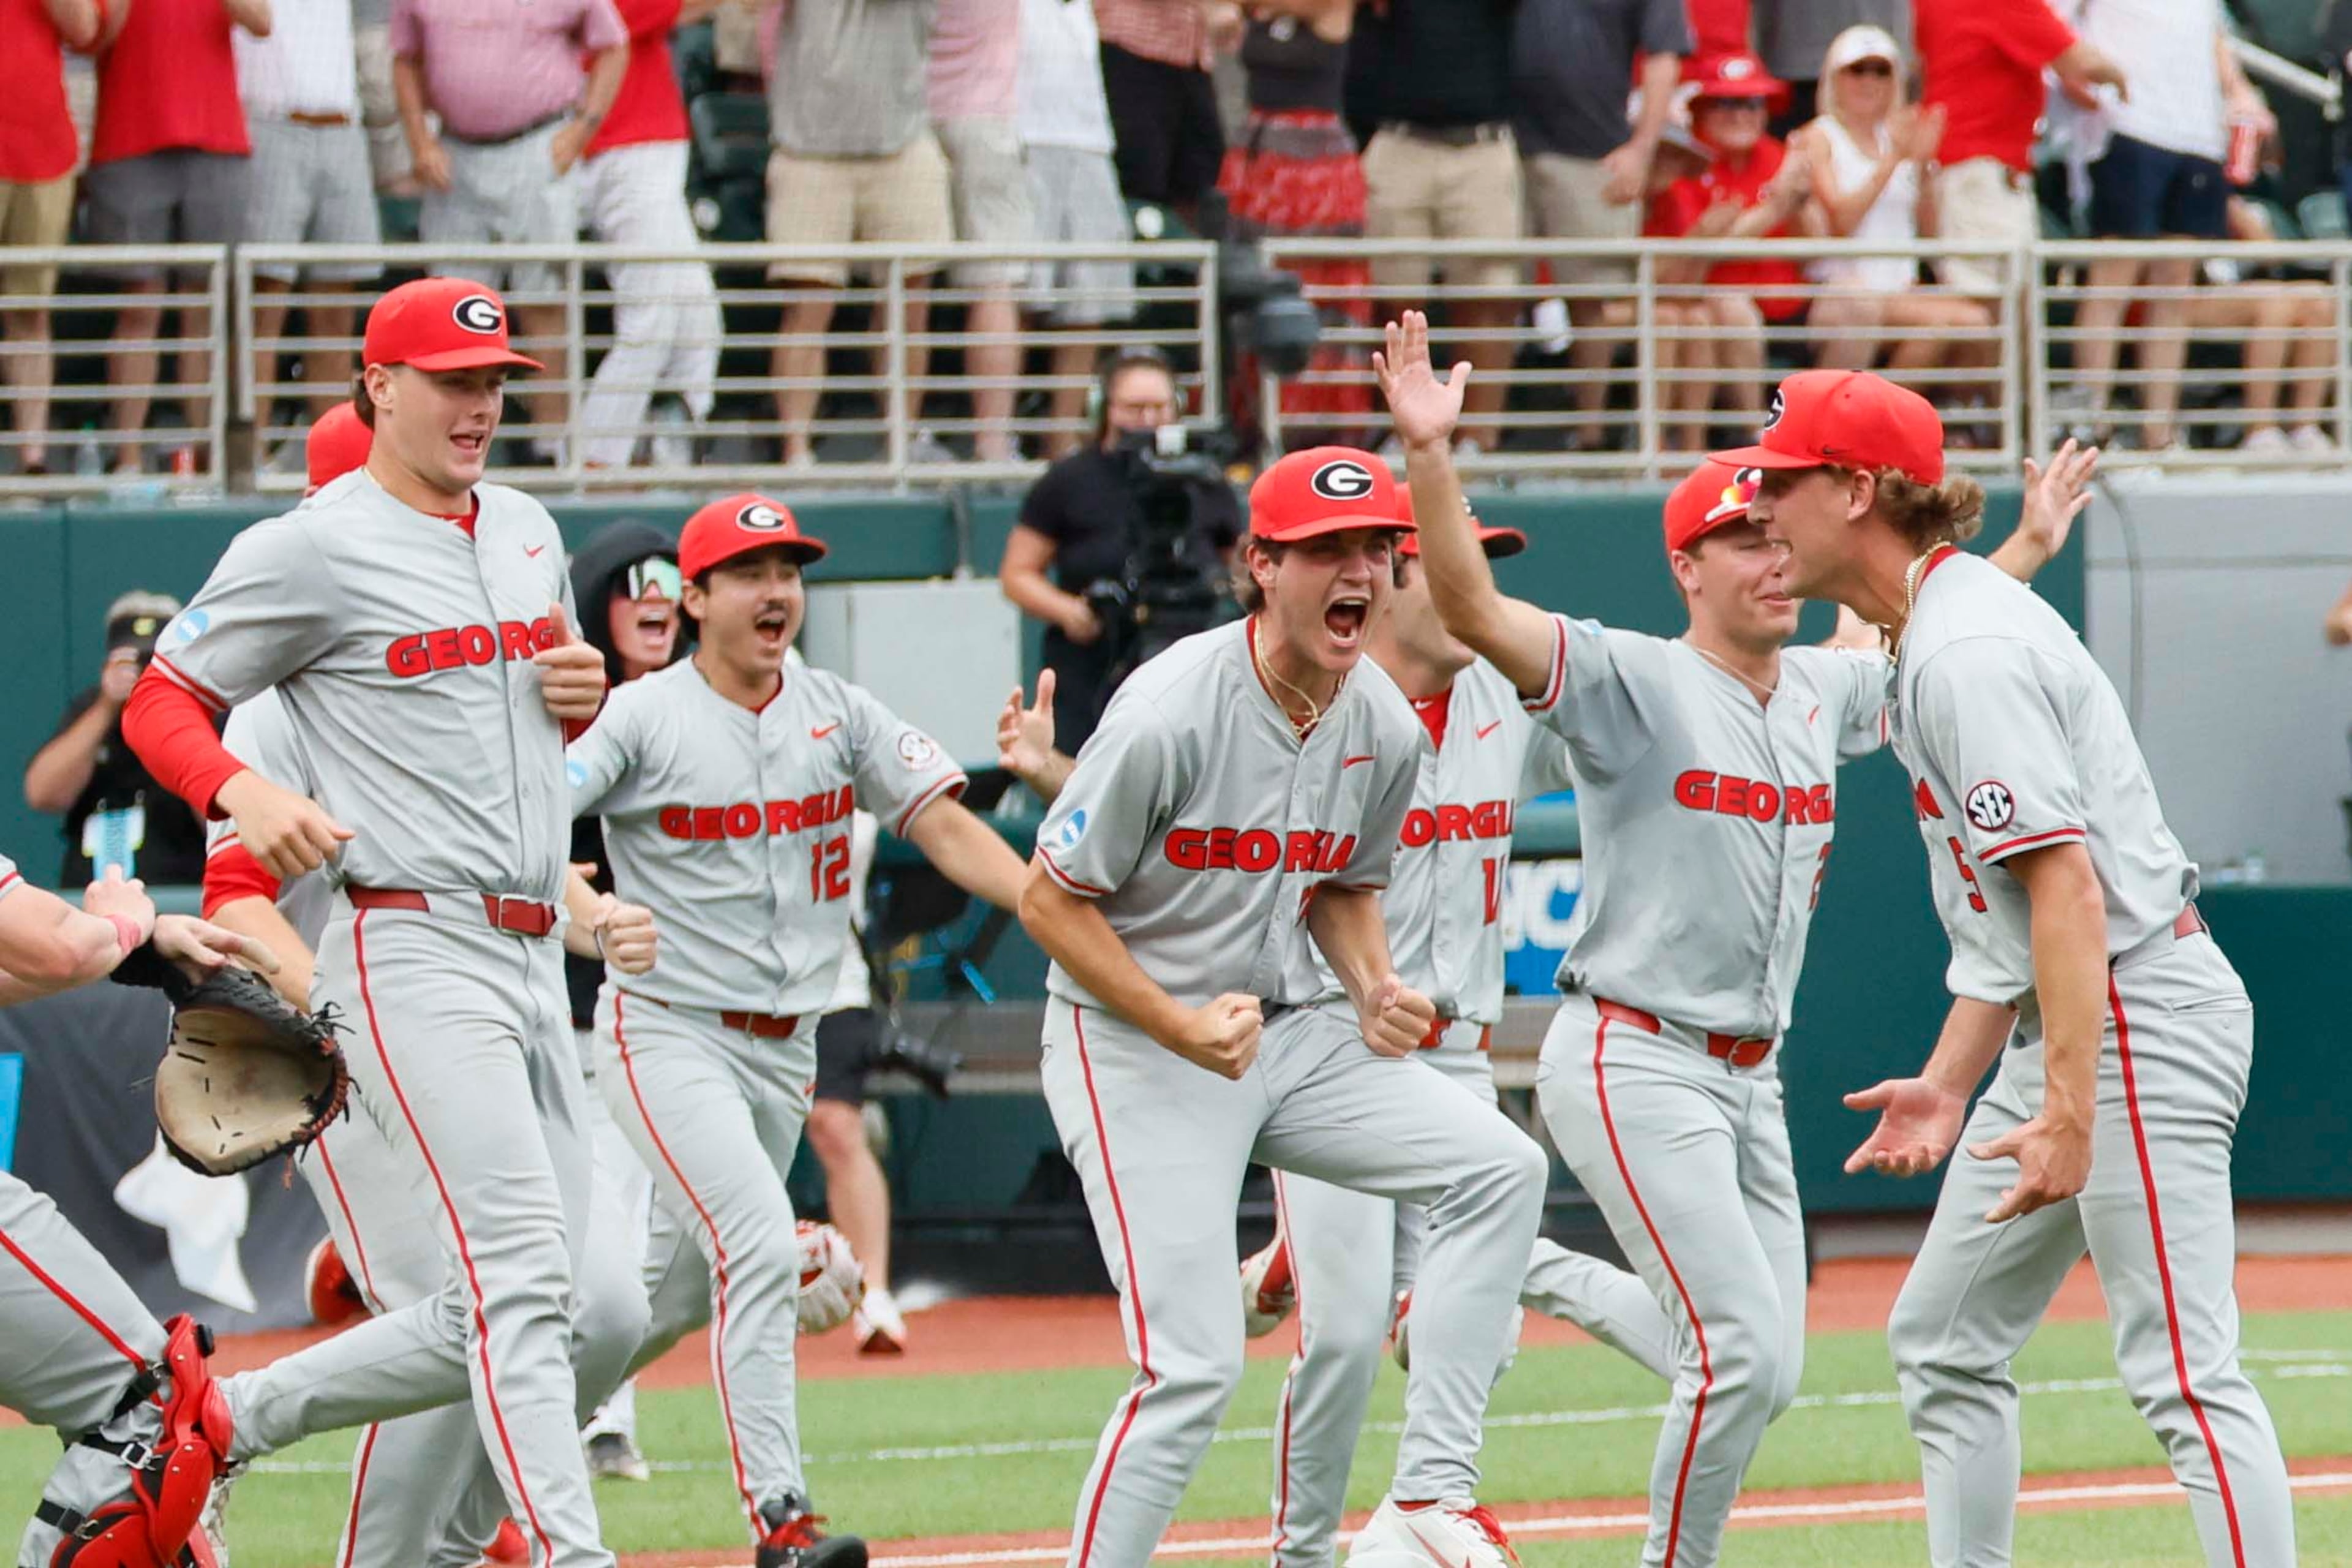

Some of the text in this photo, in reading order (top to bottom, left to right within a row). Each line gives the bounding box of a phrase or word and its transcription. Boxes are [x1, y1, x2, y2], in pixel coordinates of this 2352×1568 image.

[455, 297, 502, 331] G
[1313, 461, 1373, 498] G
[738, 503, 785, 530] G
[1967, 782, 2013, 829] SEC
[811, 834, 851, 905] 12
[1947, 835, 1988, 913] 5
